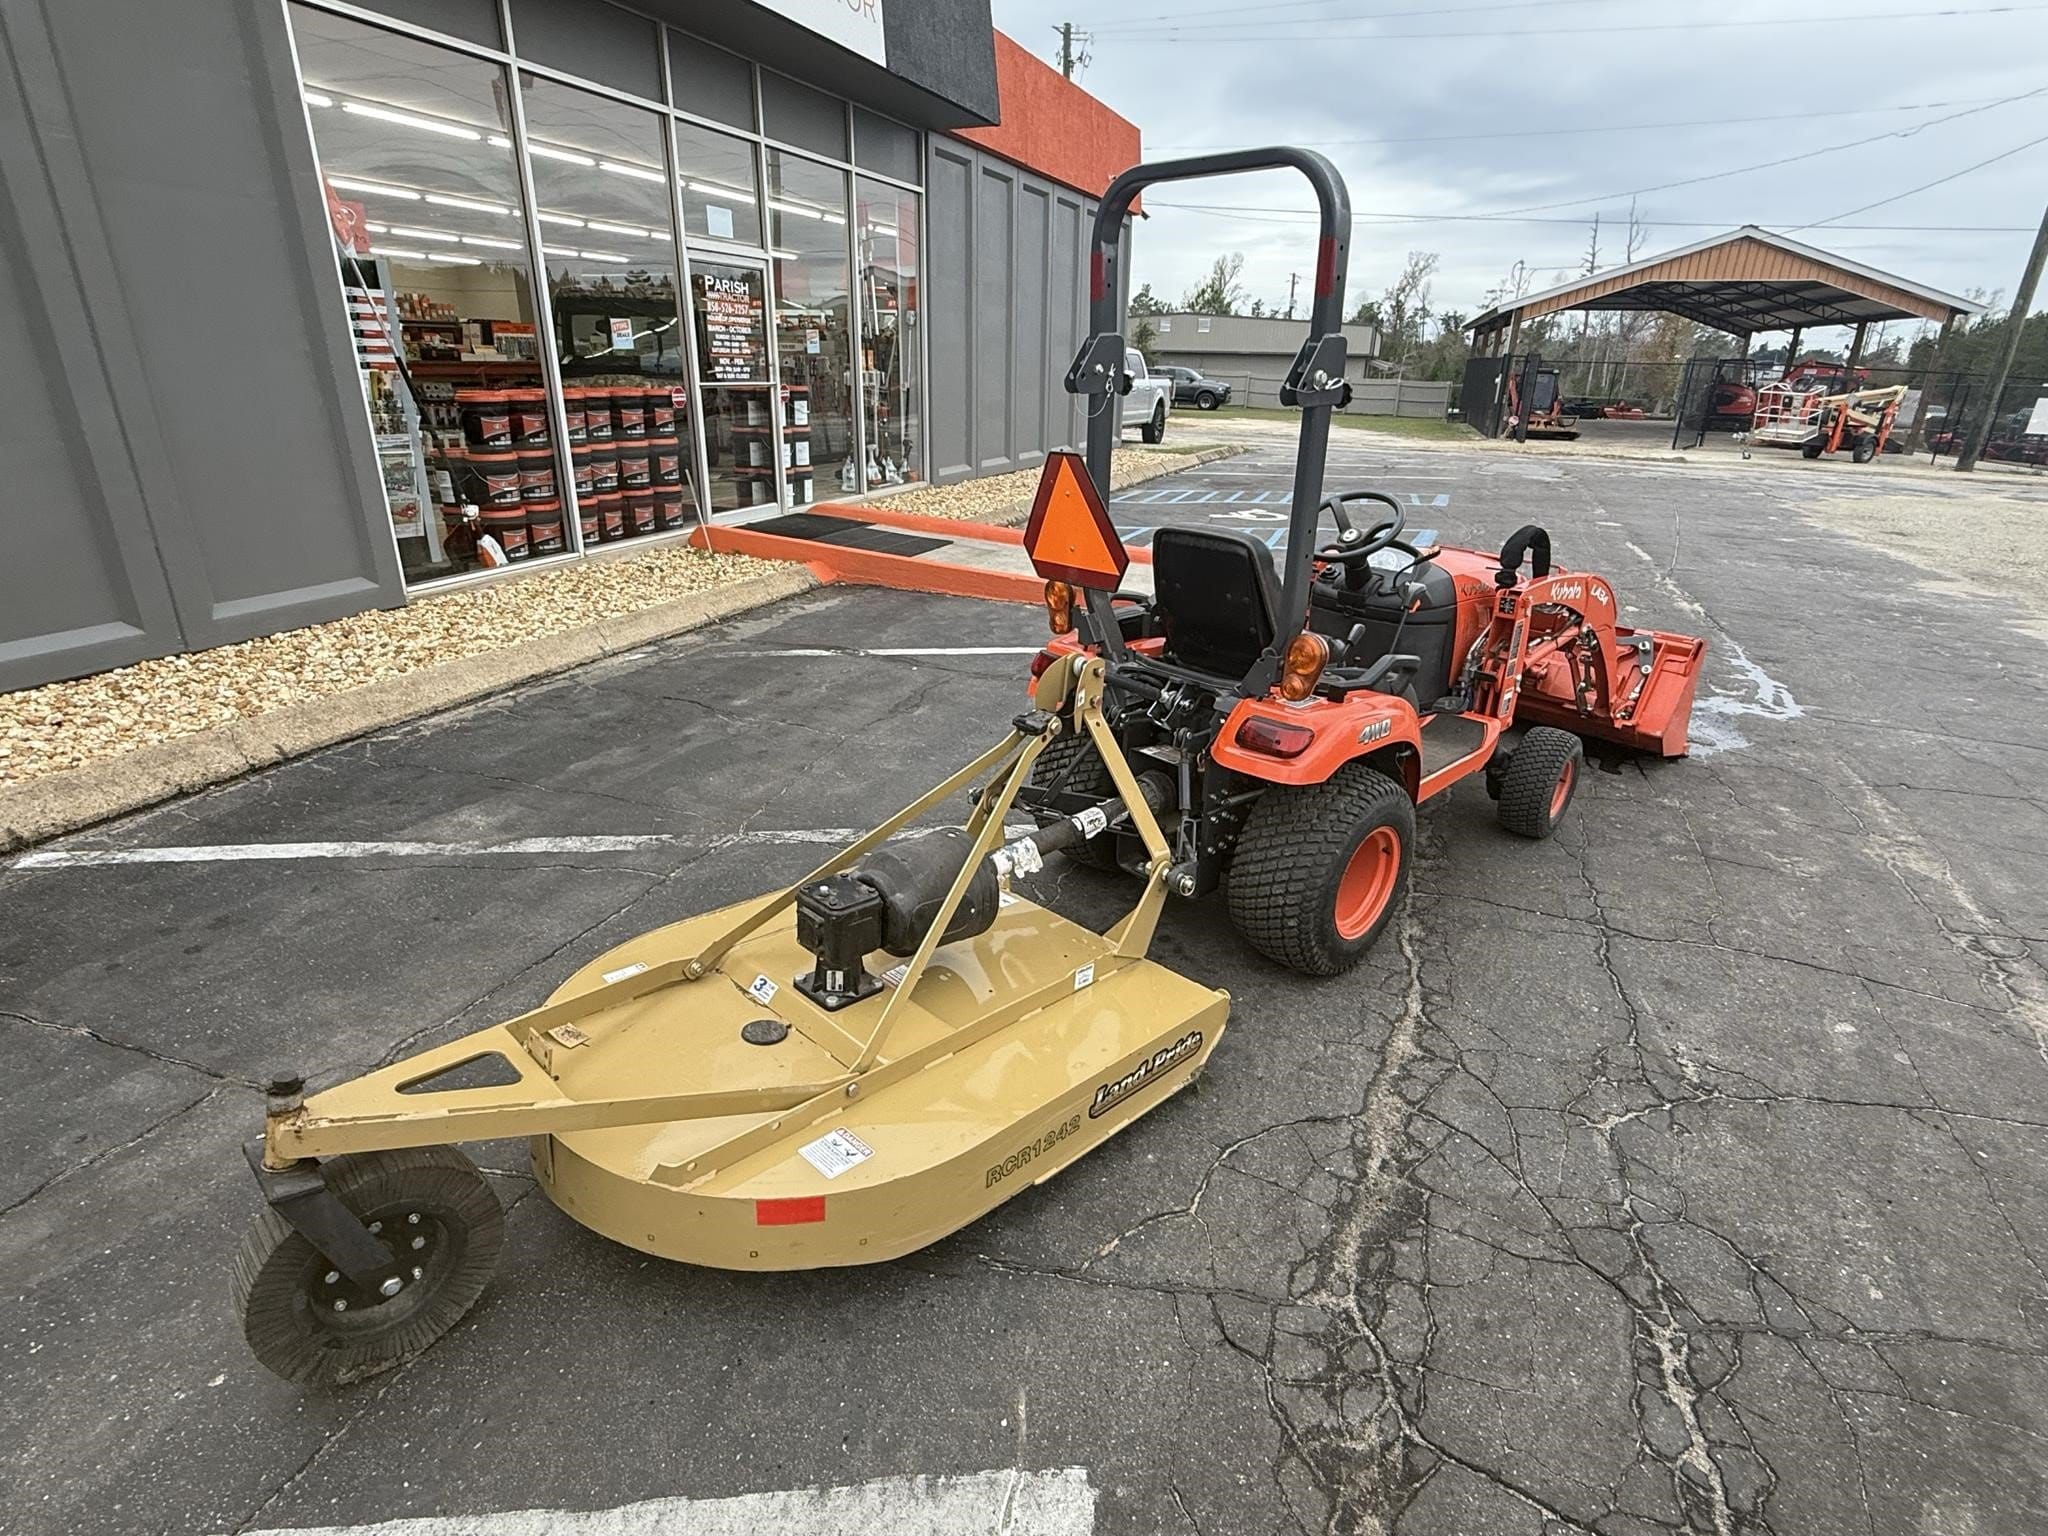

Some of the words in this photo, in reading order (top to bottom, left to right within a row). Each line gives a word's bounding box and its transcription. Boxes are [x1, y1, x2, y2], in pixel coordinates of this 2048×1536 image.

[704, 274, 749, 295] PARISH
[719, 291, 750, 304] TRACTOR
[729, 326, 752, 334] OCTOBER
[1550, 581, 1582, 600] Kubota
[1358, 718, 1391, 745] 4WD
[1091, 1060, 1151, 1105] Land
[1150, 1031, 1203, 1073] Pride
[985, 1114, 1082, 1189] RCR1242
